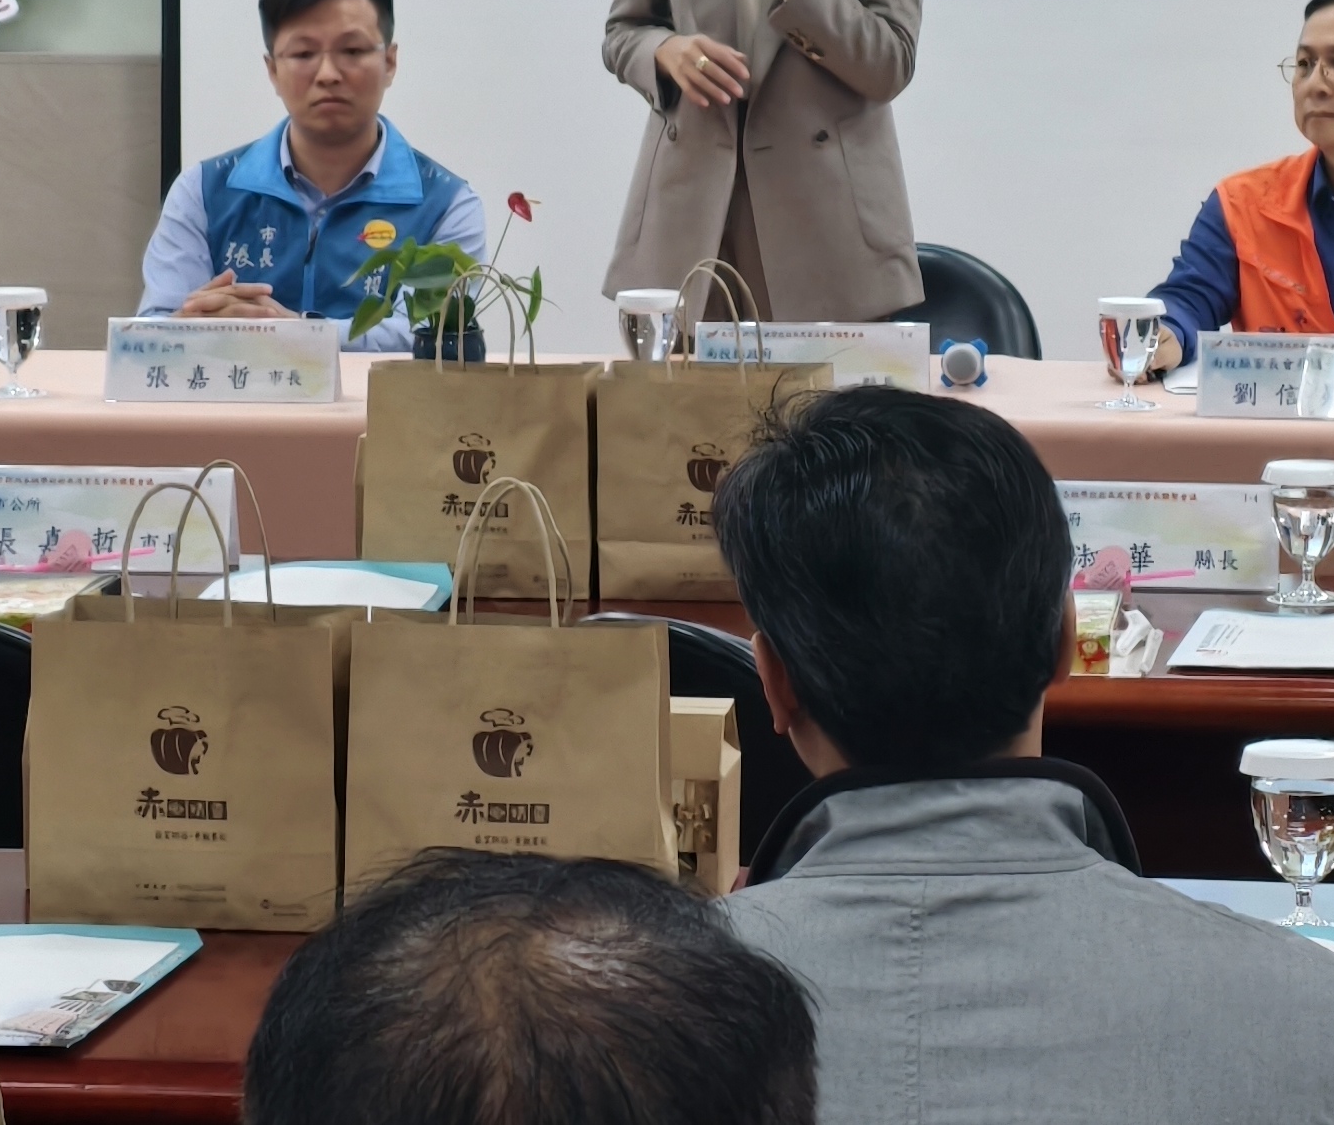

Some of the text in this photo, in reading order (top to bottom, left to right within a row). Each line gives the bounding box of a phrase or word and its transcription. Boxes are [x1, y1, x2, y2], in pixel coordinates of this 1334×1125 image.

[259, 224, 277, 268] 市長
[146, 364, 302, 390] 張嘉哲 市長
[1194, 549, 1239, 571] 縣長
